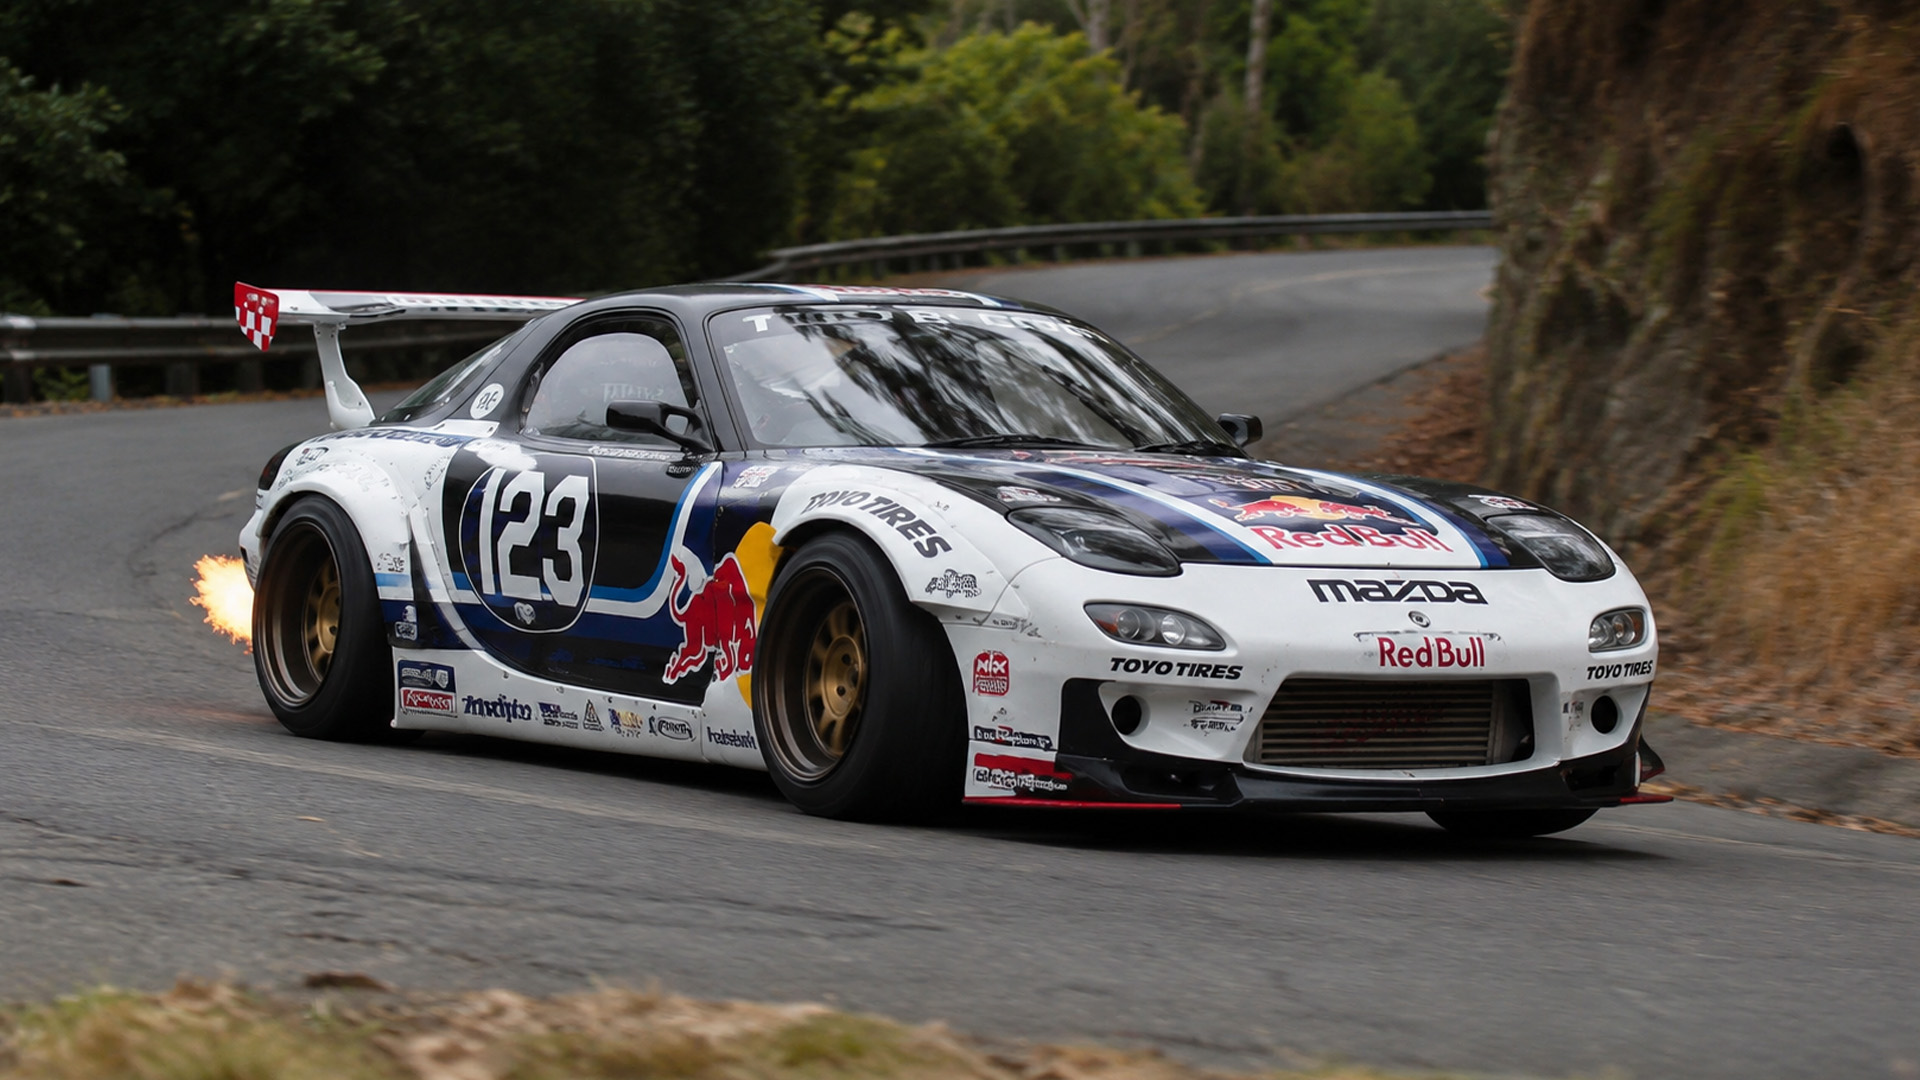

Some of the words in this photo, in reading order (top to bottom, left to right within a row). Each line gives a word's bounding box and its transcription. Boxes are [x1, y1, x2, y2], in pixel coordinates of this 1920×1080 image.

[479, 468, 589, 607] 123
[800, 490, 872, 515] TOYO
[859, 496, 952, 558] TIRES
[1252, 525, 1361, 550] Red
[1357, 525, 1453, 552] Bull
[1377, 637, 1433, 668] Red
[1434, 637, 1486, 668] Bull
[1110, 657, 1173, 675] TOYO
[1176, 662, 1243, 680] TIRES
[1587, 664, 1622, 680] TOYO
[1624, 660, 1653, 677] TIRES
